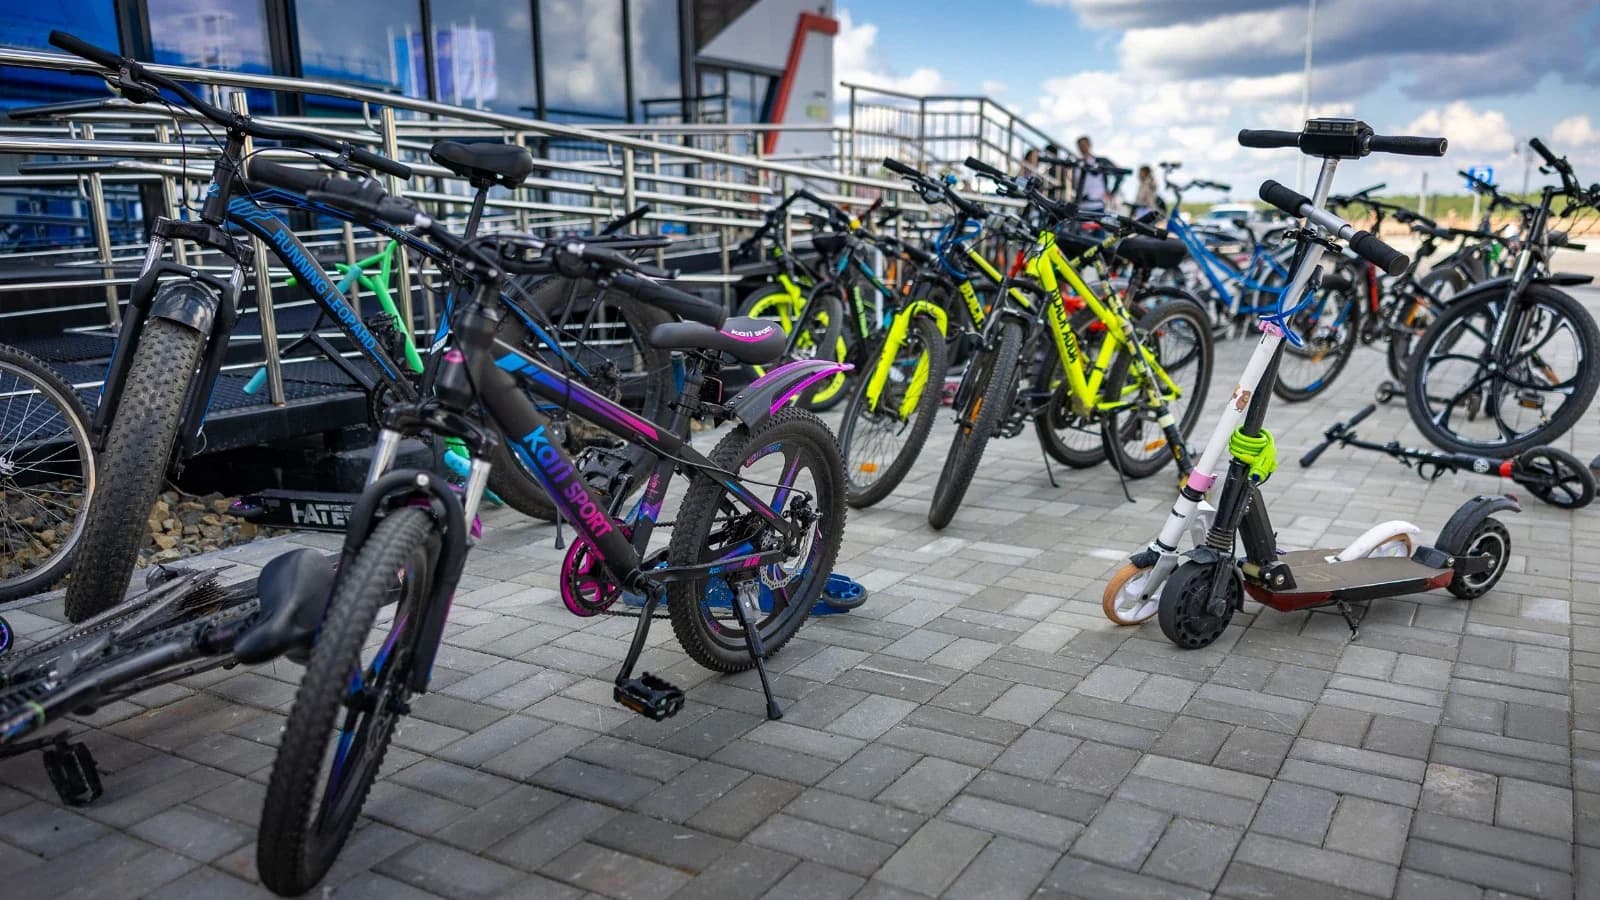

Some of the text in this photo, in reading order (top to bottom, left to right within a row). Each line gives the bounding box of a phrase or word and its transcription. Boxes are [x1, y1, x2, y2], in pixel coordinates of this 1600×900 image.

[272, 229, 376, 349] RUNNING LEOPARD
[523, 425, 613, 537] kari SPORT
